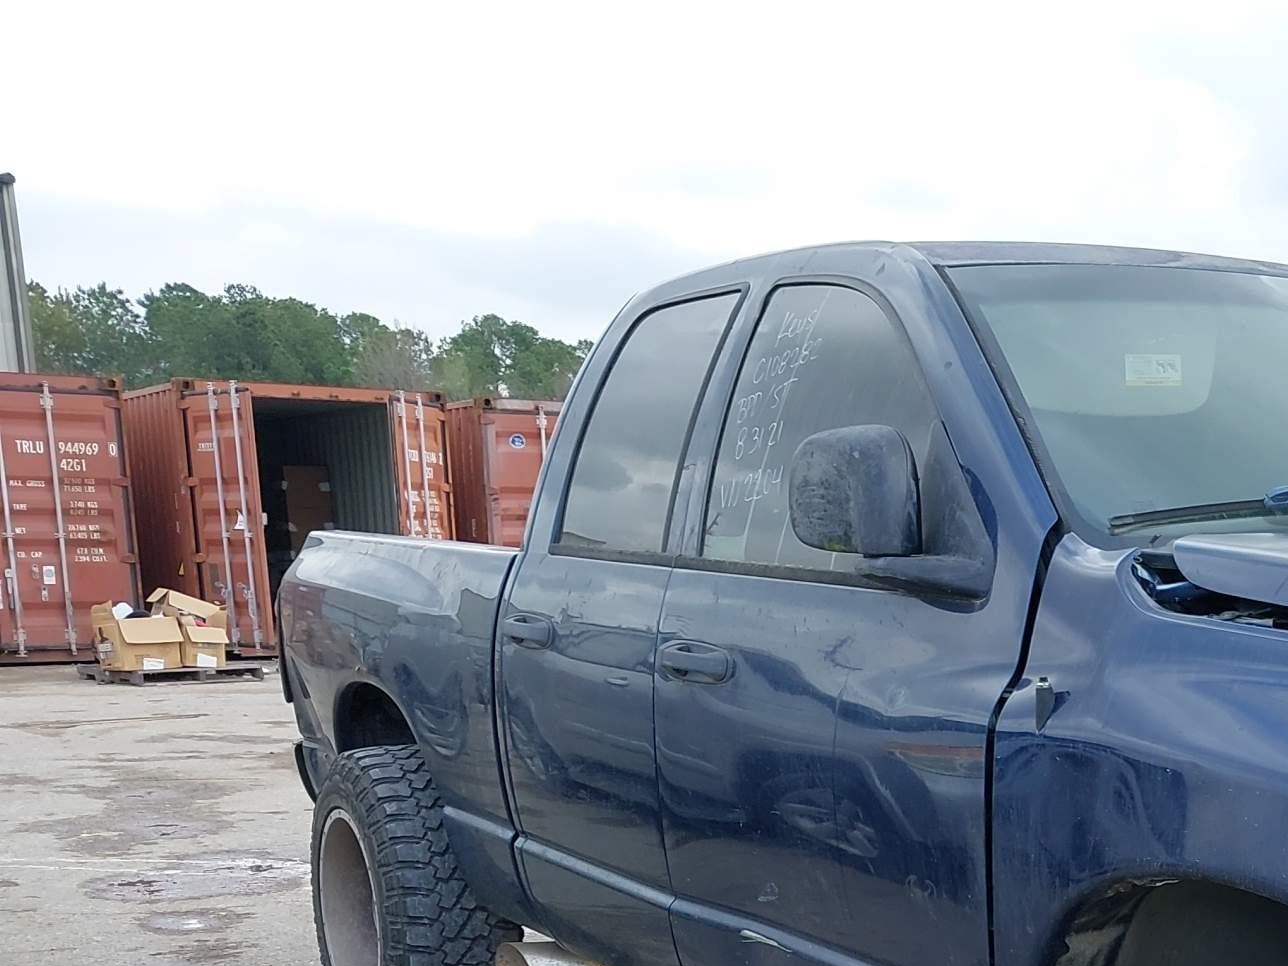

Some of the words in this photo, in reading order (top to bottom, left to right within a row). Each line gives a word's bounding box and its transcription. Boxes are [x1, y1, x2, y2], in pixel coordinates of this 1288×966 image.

[15, 439, 44, 454] TRLU
[58, 441, 99, 456] 944969
[60, 458, 87, 472] 42G1
